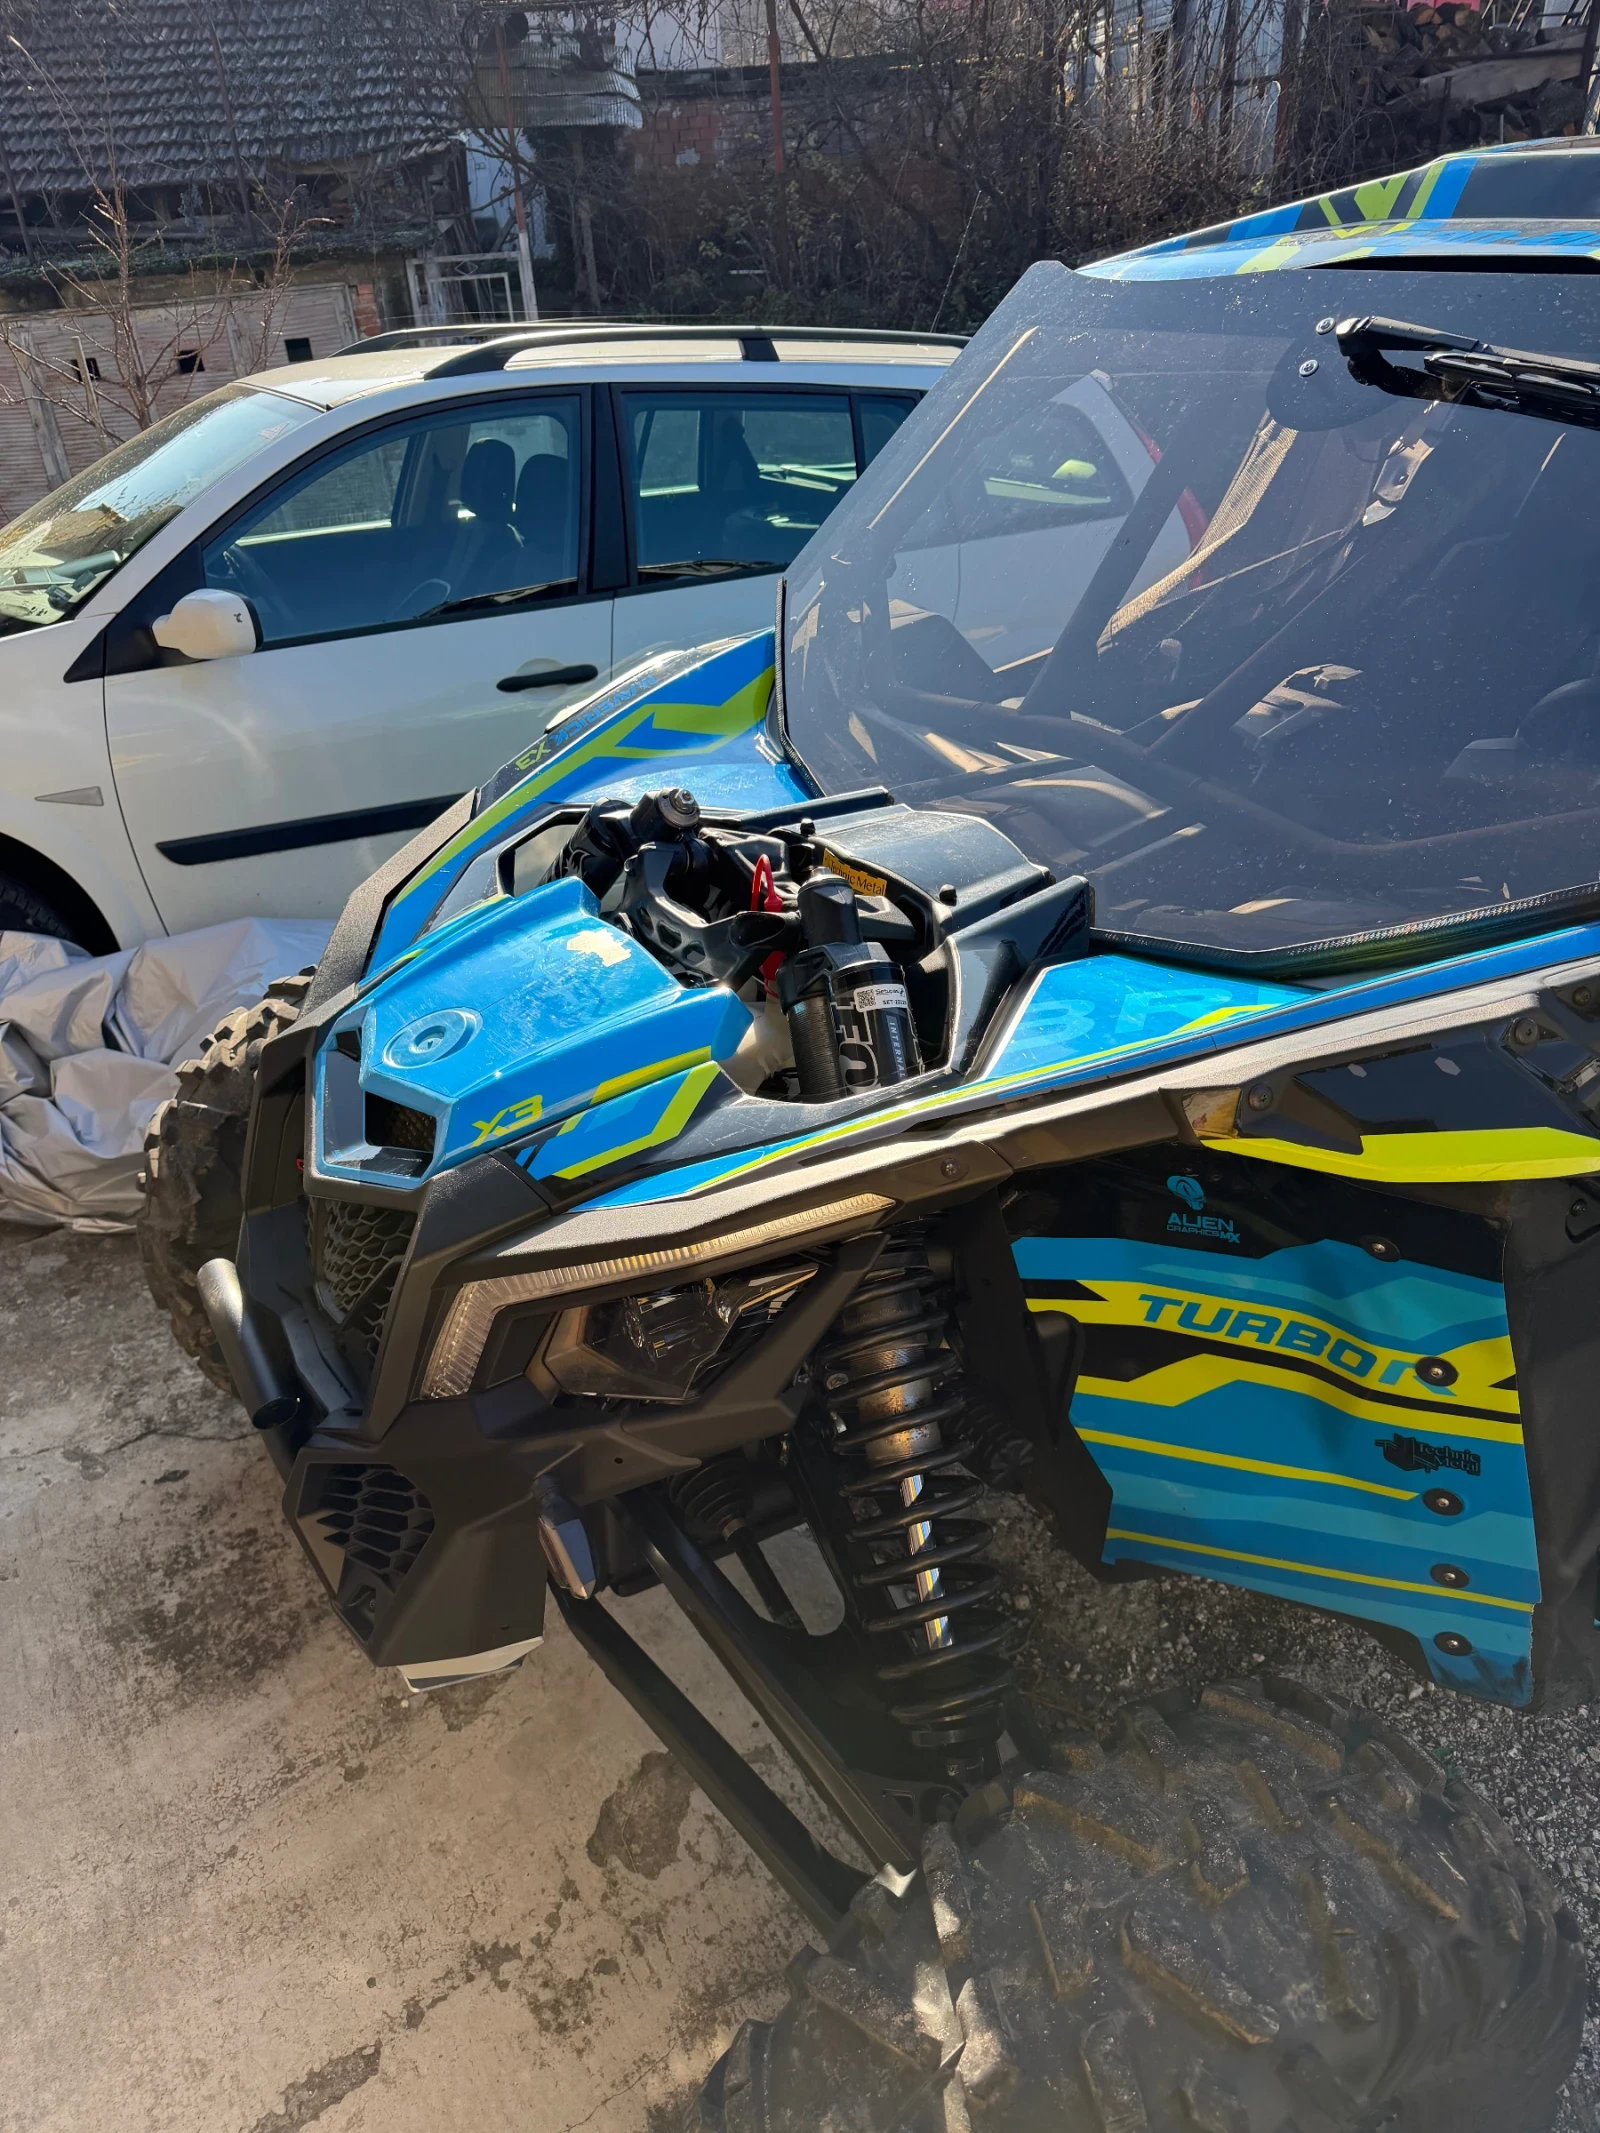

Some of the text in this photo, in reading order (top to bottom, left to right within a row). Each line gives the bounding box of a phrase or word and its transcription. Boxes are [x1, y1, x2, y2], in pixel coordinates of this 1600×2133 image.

[1361, 229, 1600, 247] can-a
[515, 674, 657, 771] MAVERICK X3
[856, 875, 886, 896] Metal
[889, 1021, 906, 1078] INTERNAL
[470, 1094, 543, 1148] X3
[1167, 1212, 1234, 1232] ALIEN
[1419, 1443, 1481, 1462] Technic
[1434, 1455, 1480, 1472] Metal
